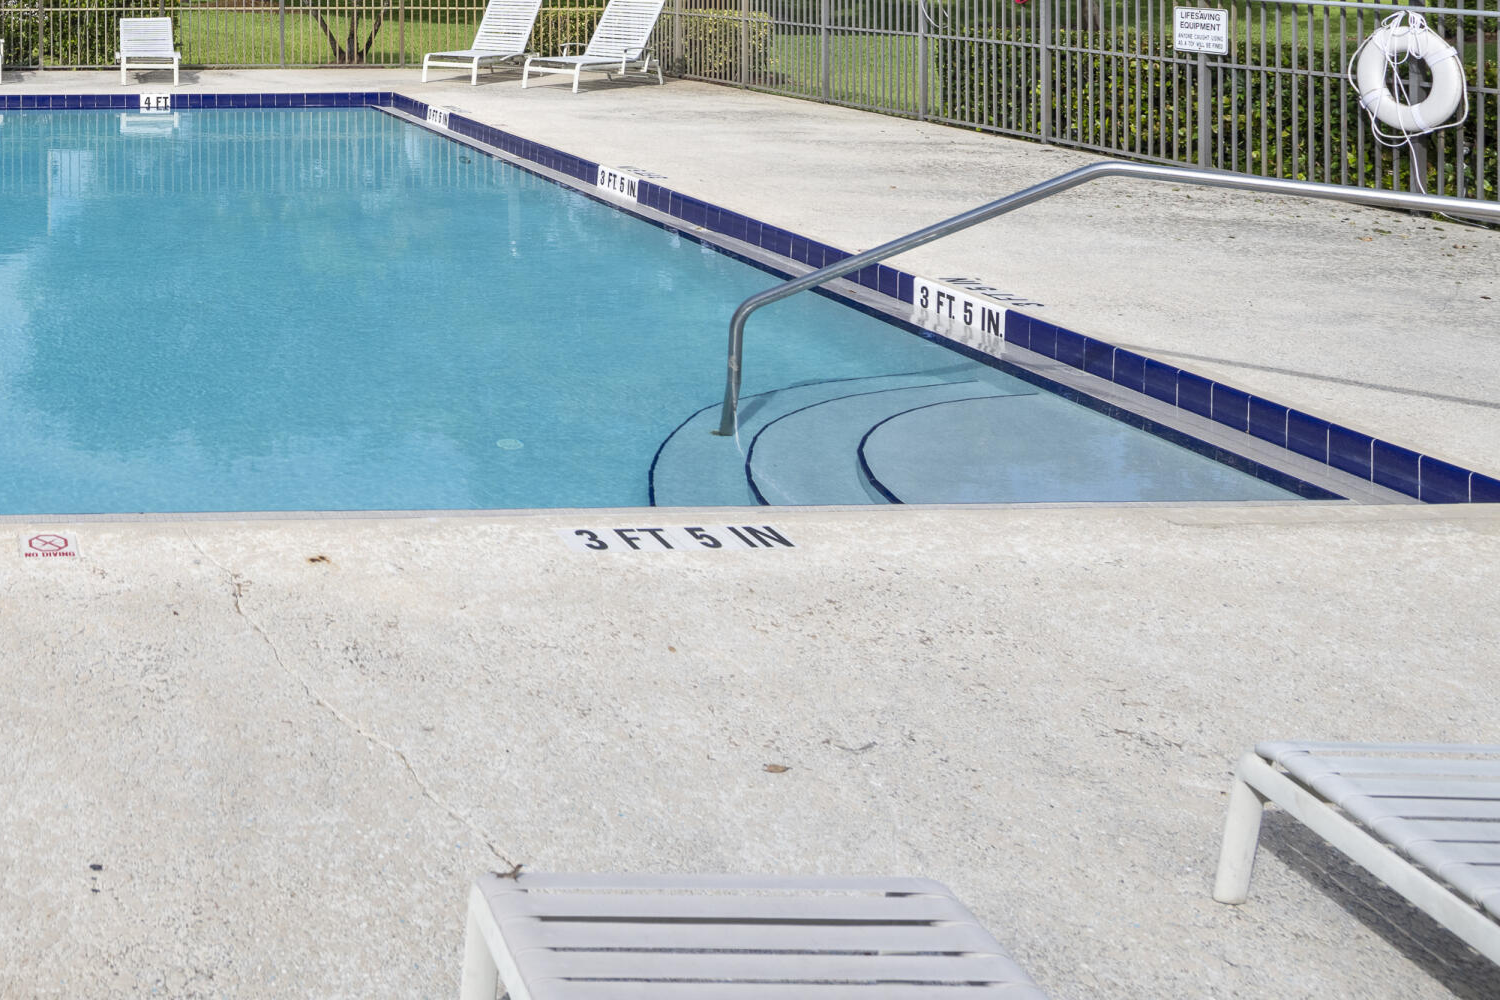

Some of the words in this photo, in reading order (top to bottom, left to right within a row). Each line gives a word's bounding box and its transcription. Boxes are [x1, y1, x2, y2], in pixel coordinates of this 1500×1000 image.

[1180, 12, 1220, 21] LIFESAVING
[1180, 22, 1220, 31] EQUIPMENT
[144, 96, 151, 110] 4
[600, 170, 606, 185] 3
[620, 177, 624, 192] 5
[920, 286, 929, 308] 3
[937, 291, 955, 320] FT.
[964, 300, 973, 326] 5
[982, 307, 1003, 337] IN.
[575, 529, 609, 550] 3
[613, 528, 674, 550] FT
[684, 527, 722, 548] 5
[727, 526, 796, 548] IN
